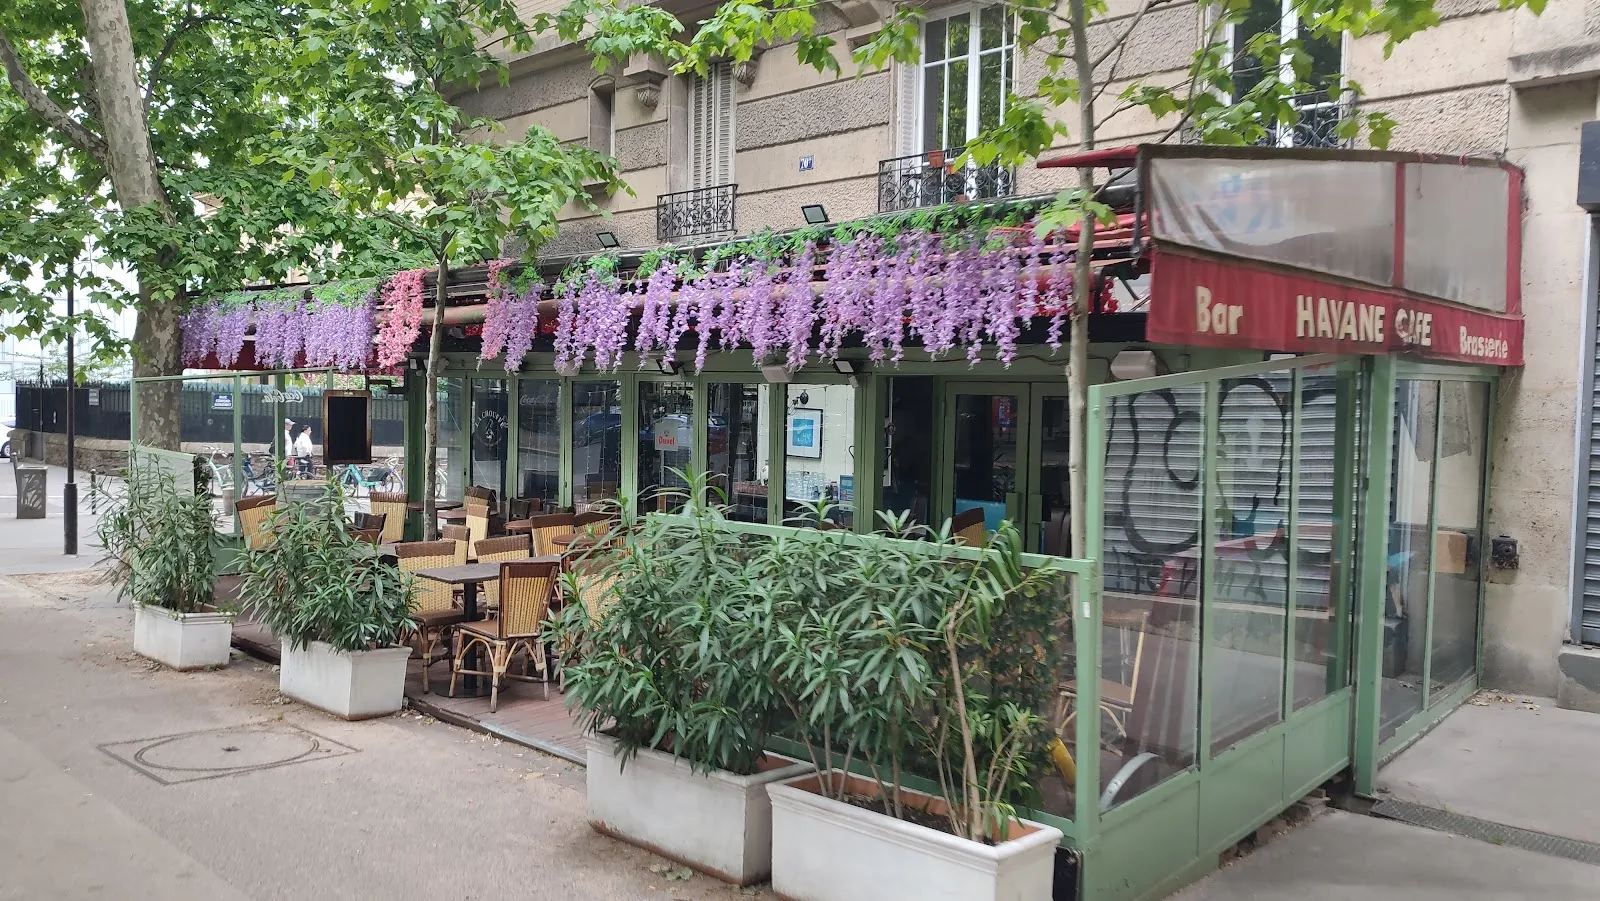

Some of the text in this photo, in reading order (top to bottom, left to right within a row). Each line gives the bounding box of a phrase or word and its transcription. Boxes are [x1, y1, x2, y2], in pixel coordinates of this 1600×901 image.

[1196, 285, 1243, 335] Bar
[1296, 294, 1385, 343] HAVANE
[1459, 325, 1508, 359] Brasserie
